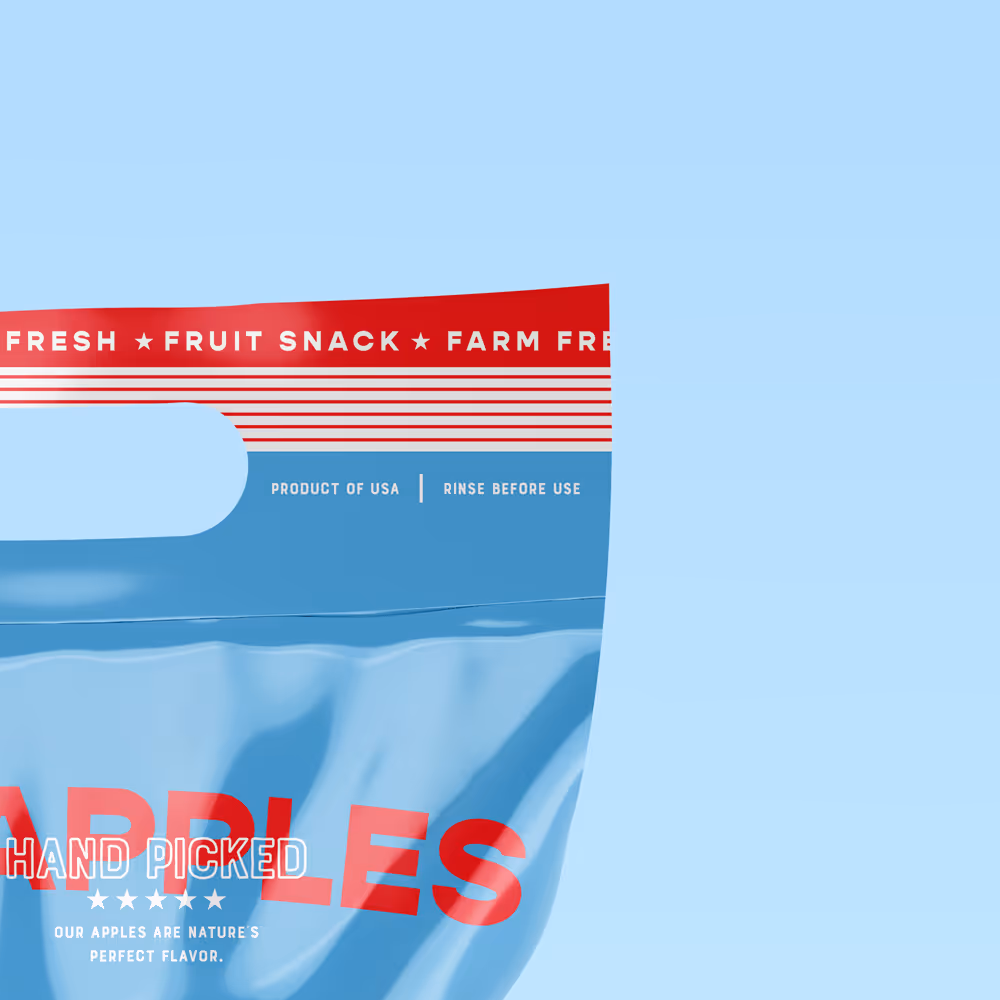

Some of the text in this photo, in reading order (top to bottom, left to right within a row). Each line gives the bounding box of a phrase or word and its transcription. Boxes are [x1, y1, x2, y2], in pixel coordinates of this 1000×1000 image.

[6, 330, 115, 352] FRESH
[165, 330, 263, 352] FRUIT
[279, 330, 399, 352] SNACK
[447, 330, 539, 352] FARM
[271, 482, 400, 495] PRODUCT OF USA
[443, 482, 581, 495] RINSE BEFORE USE
[6, 837, 308, 880] HAND PICKED
[54, 926, 84, 939] OUR
[91, 926, 147, 939] APPLES
[153, 926, 181, 939] ARE
[90, 949, 224, 962] PERFECT FLAVOR.
